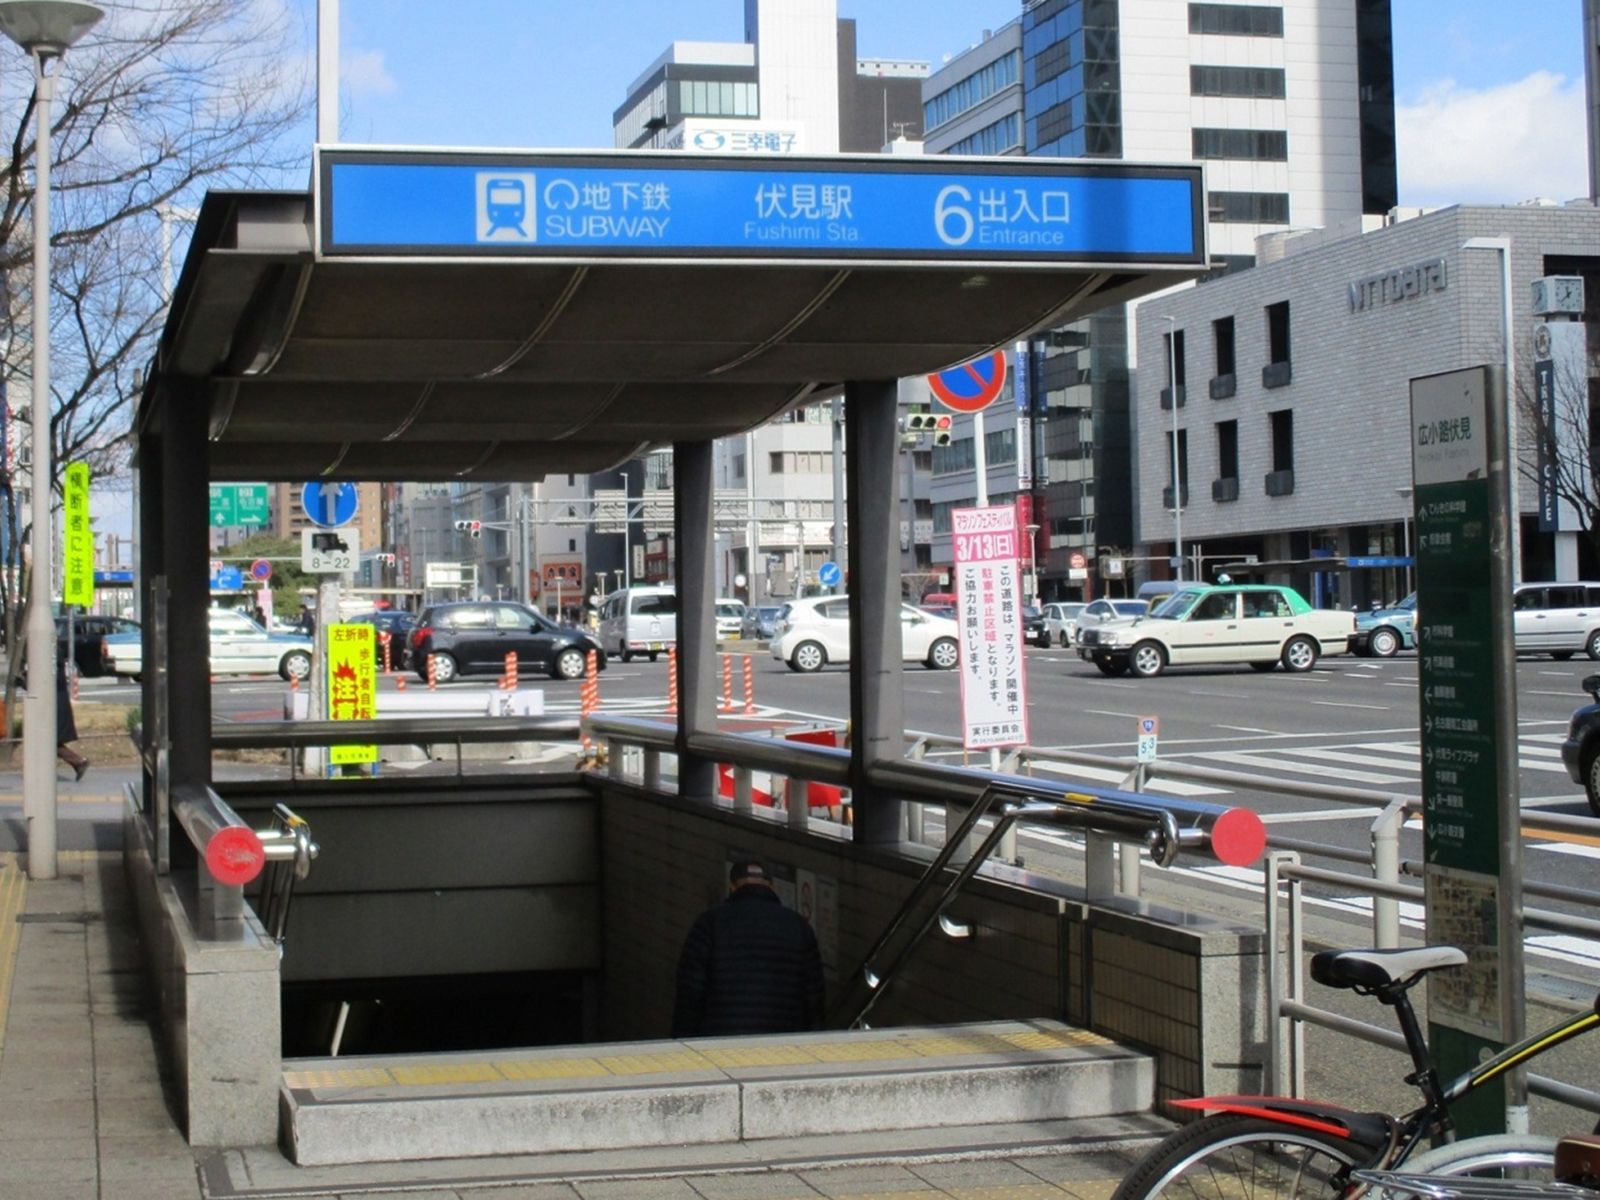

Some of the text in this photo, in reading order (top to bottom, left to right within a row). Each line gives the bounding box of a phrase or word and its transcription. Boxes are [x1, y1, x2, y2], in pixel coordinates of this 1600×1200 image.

[731, 132, 797, 152] 三幸電子
[581, 180, 671, 211] 地下鉄
[754, 183, 853, 219] 伏見駅
[979, 190, 1070, 224] 出入口
[545, 214, 671, 239] SUBWAY
[744, 221, 820, 240] Fushimi
[934, 184, 975, 247] 6
[979, 226, 1065, 246] Entrance
[1418, 416, 1471, 446] 広小路伏見
[70, 471, 84, 596] 横断者に注意
